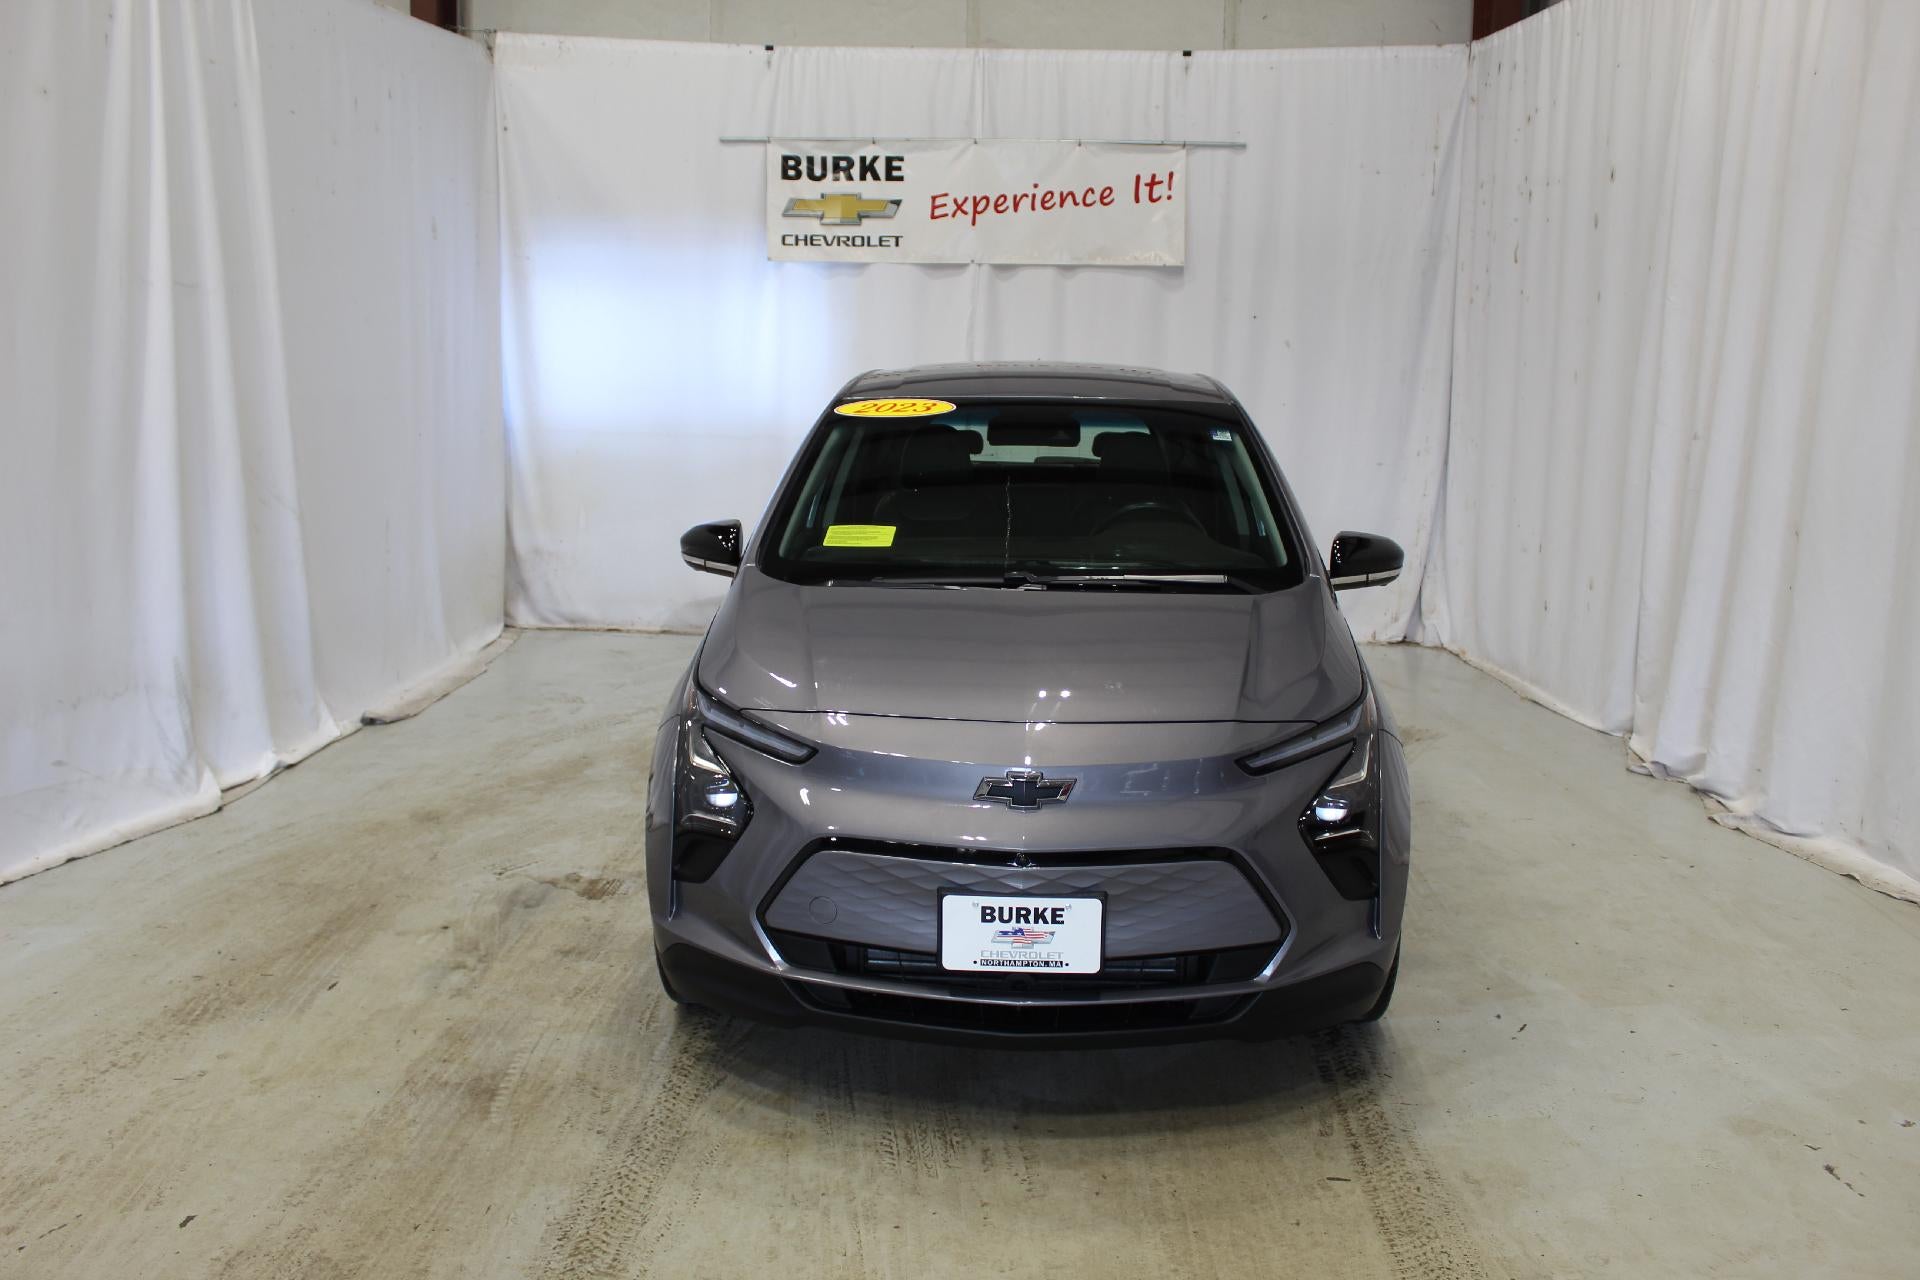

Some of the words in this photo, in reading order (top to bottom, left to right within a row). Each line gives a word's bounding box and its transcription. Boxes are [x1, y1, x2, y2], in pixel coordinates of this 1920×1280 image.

[780, 154, 904, 182] BURKE
[929, 183, 1115, 226] Experience
[1133, 171, 1175, 204] It!
[781, 234, 904, 248] CHEVROLET
[853, 402, 937, 414] 2023
[980, 905, 1065, 925] BURKE
[980, 950, 1064, 959] CHEVROLET
